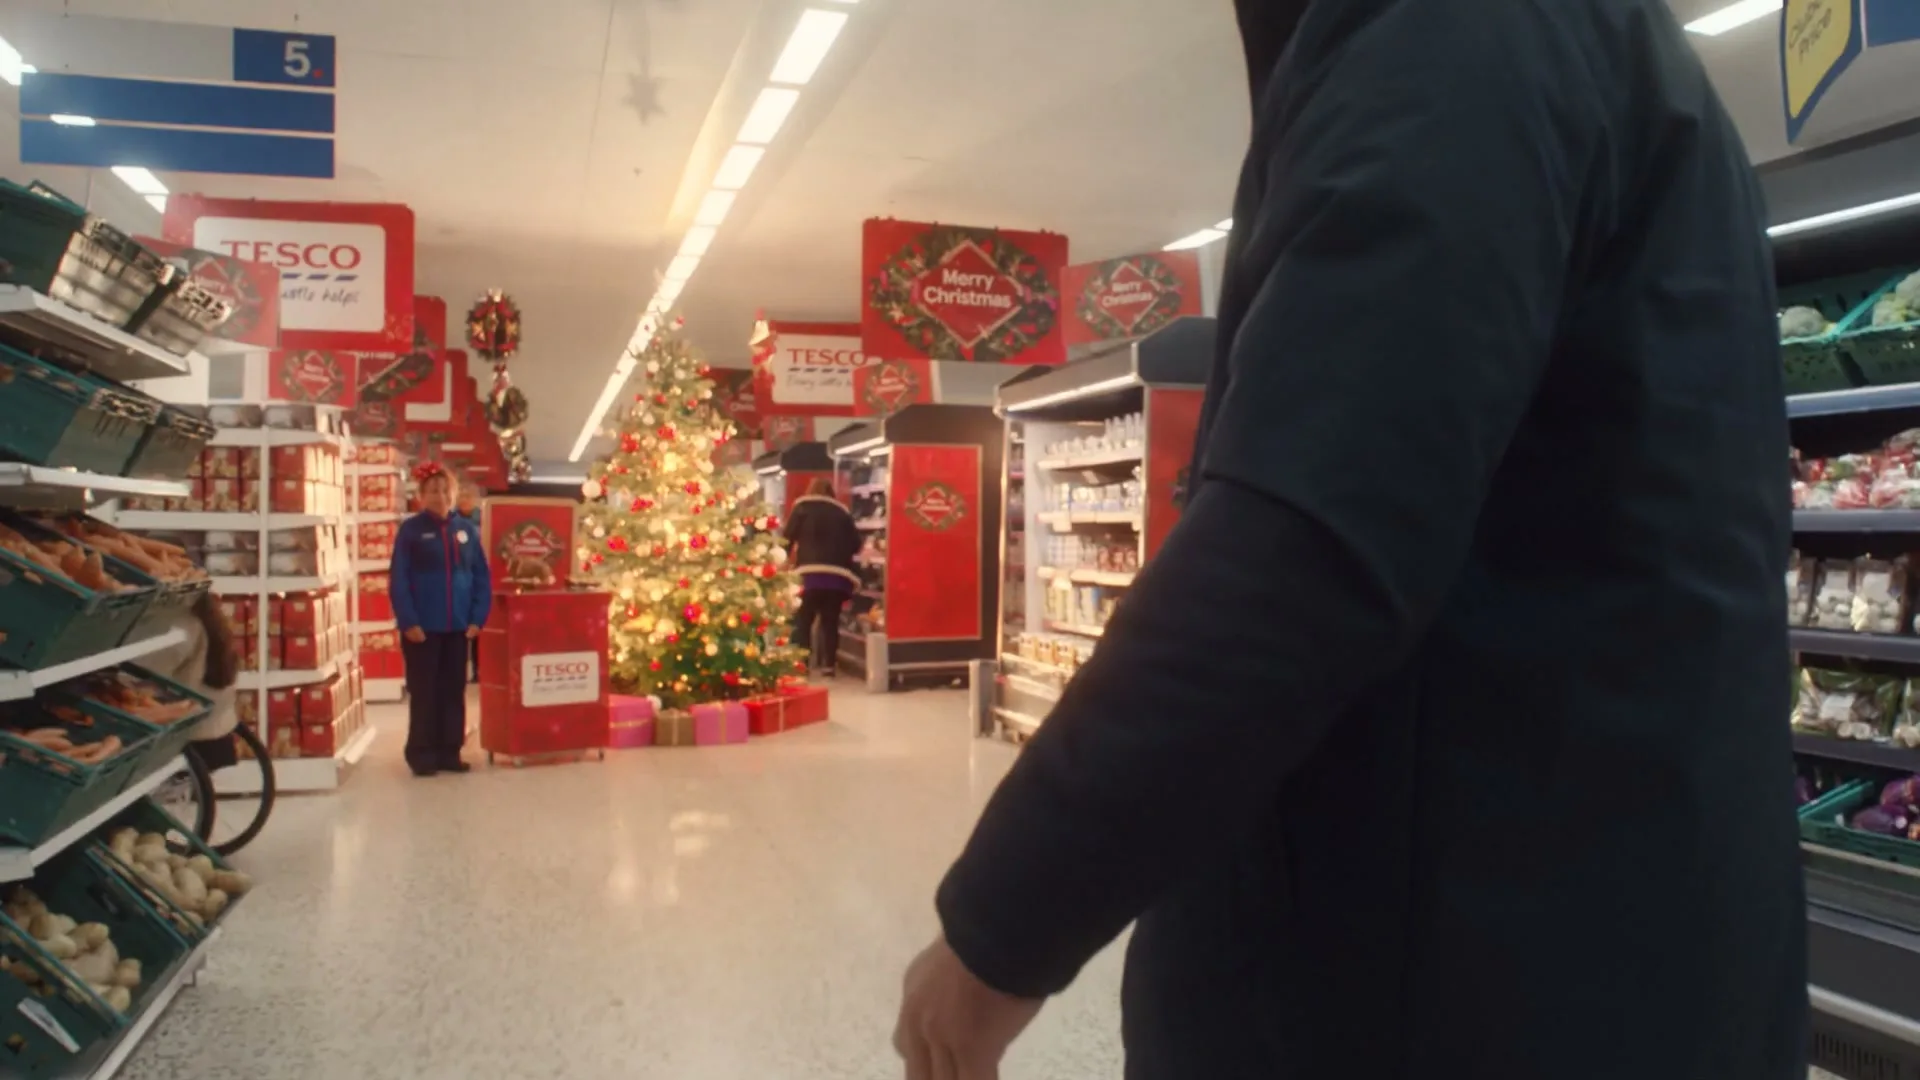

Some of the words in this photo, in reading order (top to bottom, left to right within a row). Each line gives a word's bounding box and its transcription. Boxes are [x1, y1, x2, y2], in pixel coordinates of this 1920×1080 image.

[220, 240, 361, 270] TESCO
[942, 267, 995, 292] Merry
[923, 285, 1012, 309] Christmas
[786, 348, 869, 366] TESCO
[532, 662, 590, 677] TESCO
